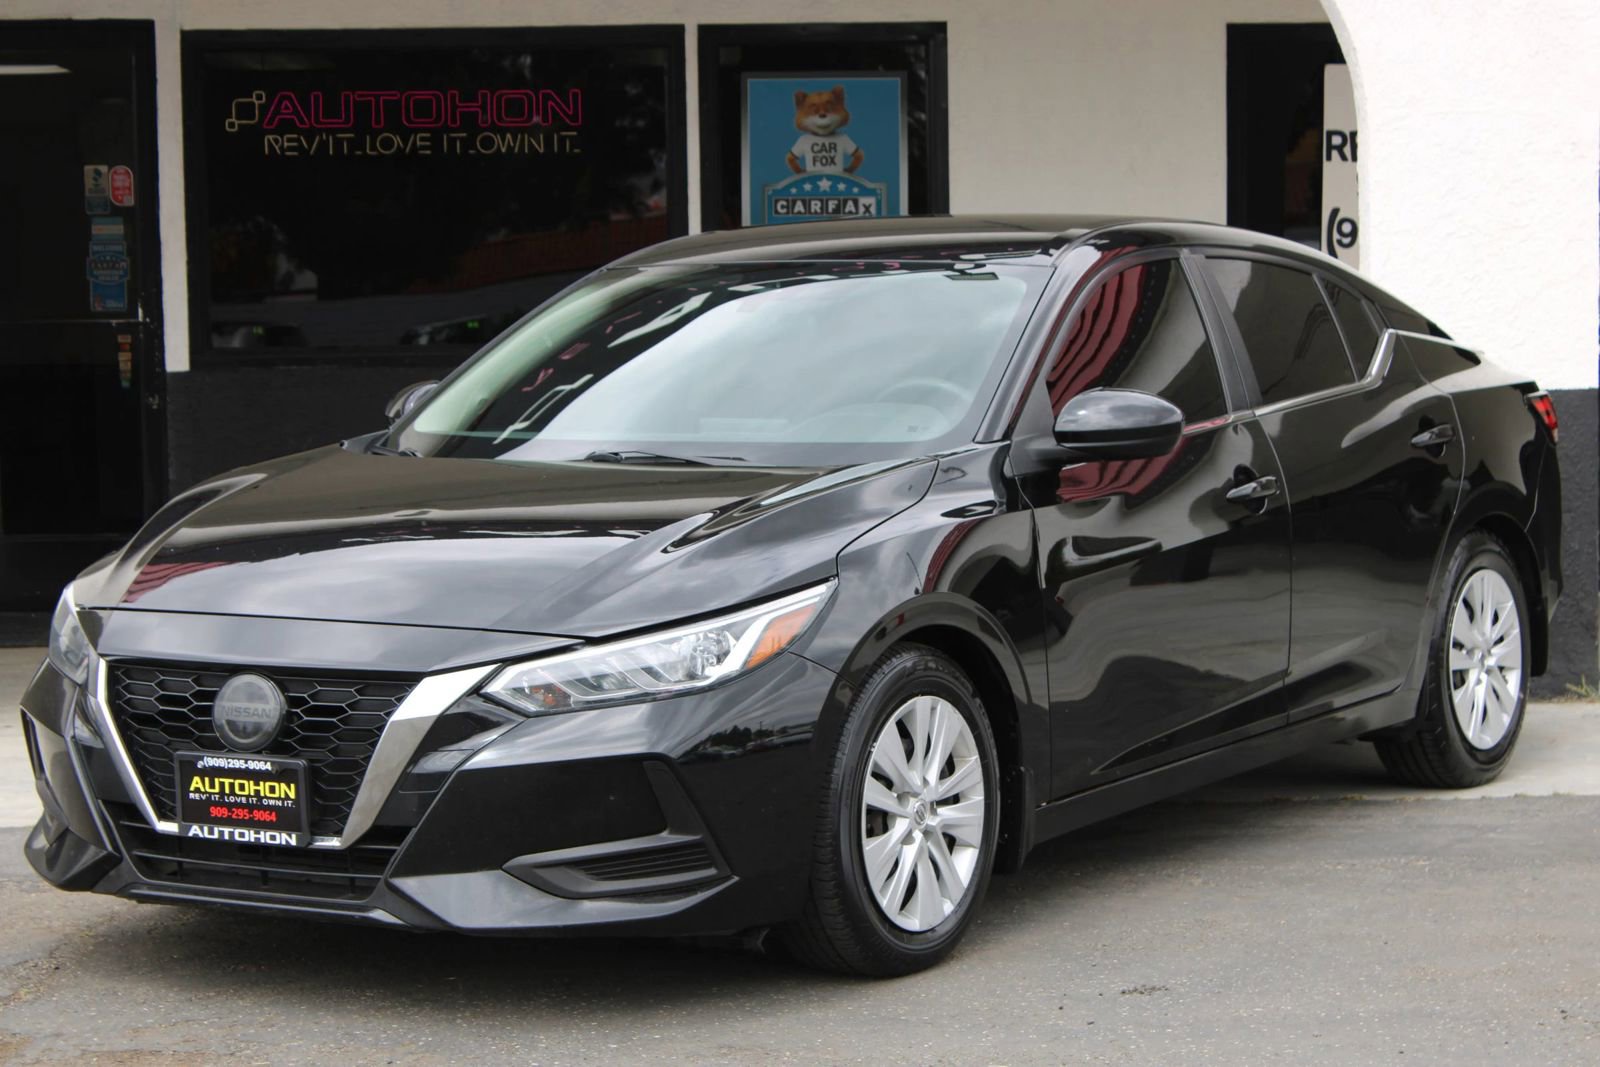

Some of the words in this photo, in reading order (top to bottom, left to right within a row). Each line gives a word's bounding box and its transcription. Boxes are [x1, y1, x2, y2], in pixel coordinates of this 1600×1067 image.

[263, 89, 582, 128] AUTOHON
[366, 132, 432, 154] LOVE
[476, 131, 545, 154] OWN
[811, 142, 837, 154] CAR
[812, 155, 837, 167] FOX
[776, 200, 873, 216] CARFAX
[223, 704, 272, 719] NISSAN
[203, 756, 272, 771] (909)295-9064
[189, 776, 296, 799] AUTOHON
[224, 795, 247, 804] LOVE
[262, 798, 282, 807] OWN
[209, 806, 277, 822] 909-295-9064
[188, 825, 297, 846] AUTOHON
